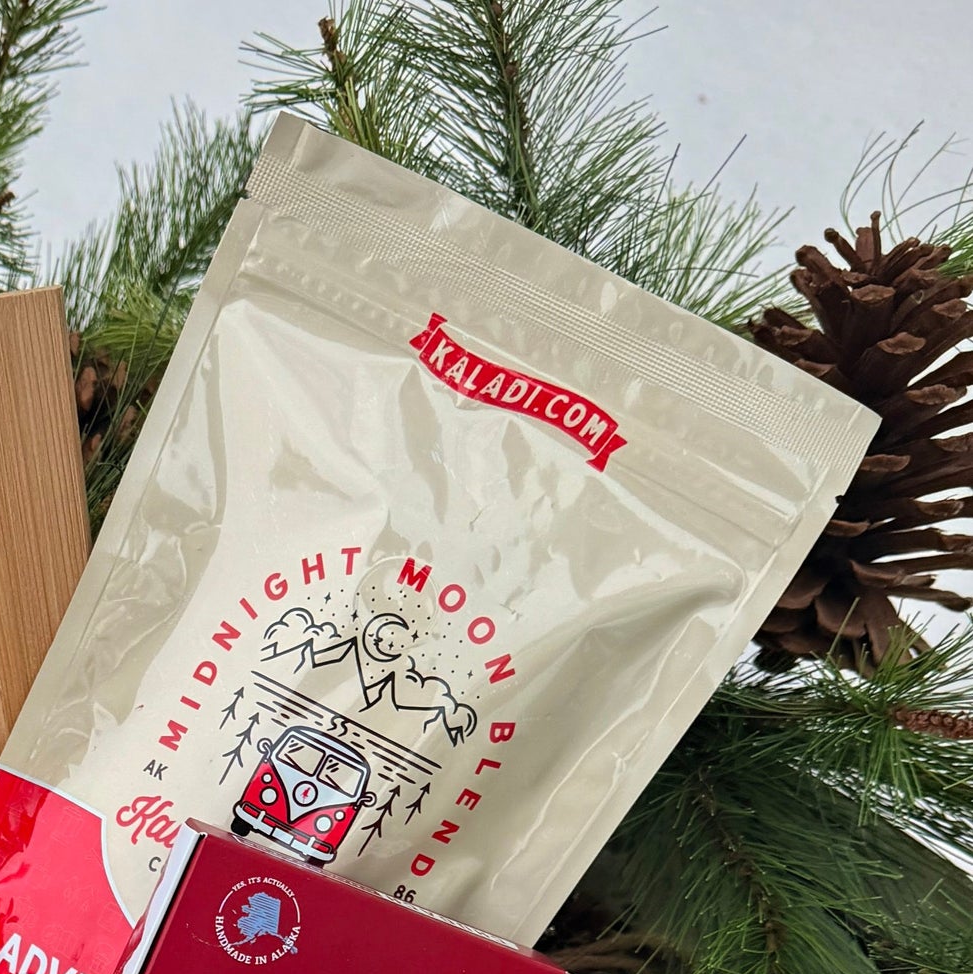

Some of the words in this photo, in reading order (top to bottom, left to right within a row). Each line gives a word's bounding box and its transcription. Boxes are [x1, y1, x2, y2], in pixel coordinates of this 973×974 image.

[429, 338, 608, 447] KALADI.COM
[158, 546, 362, 752] MIDNIGHT
[396, 556, 516, 685] MOON
[143, 759, 169, 781] AK
[410, 722, 516, 877] BLEND
[262, 876, 295, 898] ACTUALLY
[393, 884, 417, 903] 86
[215, 915, 252, 965] HANDMADE
[254, 955, 268, 965] IN
[270, 926, 301, 962] ALASKA
